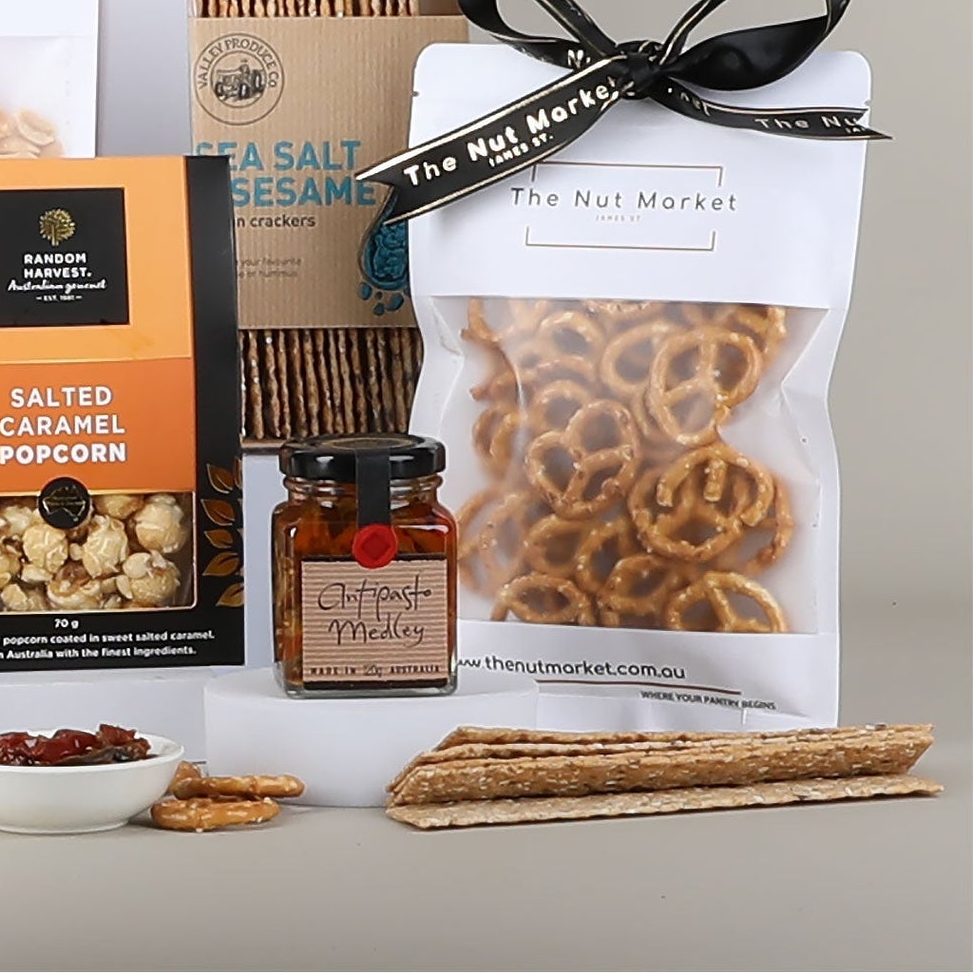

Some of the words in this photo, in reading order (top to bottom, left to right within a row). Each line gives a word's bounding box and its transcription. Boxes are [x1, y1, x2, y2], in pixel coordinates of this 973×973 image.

[198, 42, 224, 90] VALLEY
[224, 37, 278, 70] PRODUCE
[754, 117, 810, 129] The
[273, 140, 362, 172] SALT
[403, 155, 458, 186] The
[467, 126, 519, 162] Nut
[231, 176, 377, 208] SESAME
[511, 186, 560, 206] The
[574, 189, 623, 209] Nut
[637, 190, 739, 211] Market
[249, 213, 317, 228] crackers
[23, 252, 87, 265] RANDOM
[10, 386, 112, 408] SALTED
[54, 617, 69, 628] 70
[71, 619, 79, 629] g
[328, 611, 425, 647] Medley
[3, 634, 48, 646] popcorn
[50, 633, 87, 644] coated
[89, 632, 100, 643] in
[102, 632, 133, 643] sweet
[135, 631, 168, 641] salted
[6, 648, 54, 660] Australia
[55, 647, 79, 658] with
[81, 648, 99, 658] the
[101, 646, 131, 657] finest
[133, 644, 197, 657] ingredients.
[390, 664, 439, 675] AUSTRALIA
[457, 655, 686, 679] ww.thenutmarket.com.au
[640, 690, 674, 702] WHERE
[675, 692, 703, 704] YOUR
[704, 695, 740, 708] PANTRY
